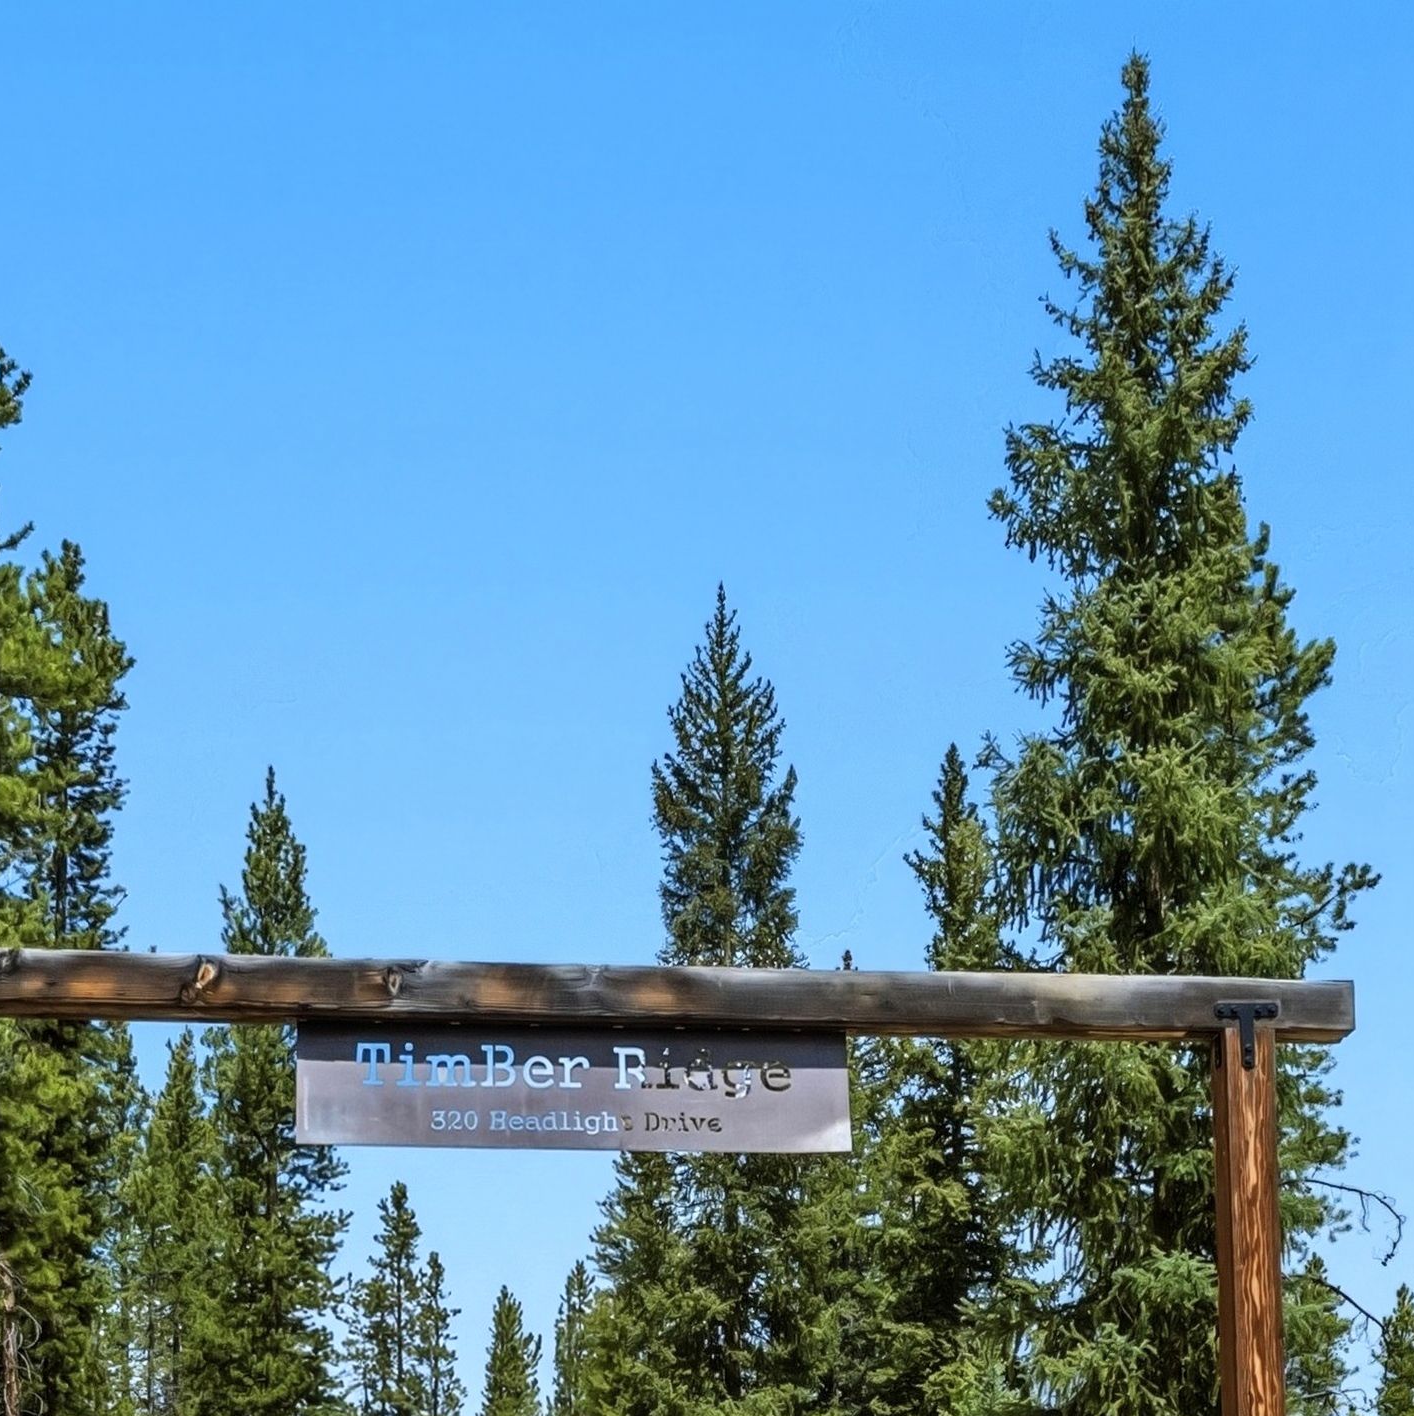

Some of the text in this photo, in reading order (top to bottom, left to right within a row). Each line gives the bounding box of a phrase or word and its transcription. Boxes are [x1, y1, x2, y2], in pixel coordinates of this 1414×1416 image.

[356, 1042, 792, 1099] TimBer Ridge
[430, 1110, 478, 1131] 320
[644, 1112, 722, 1133] Drive
